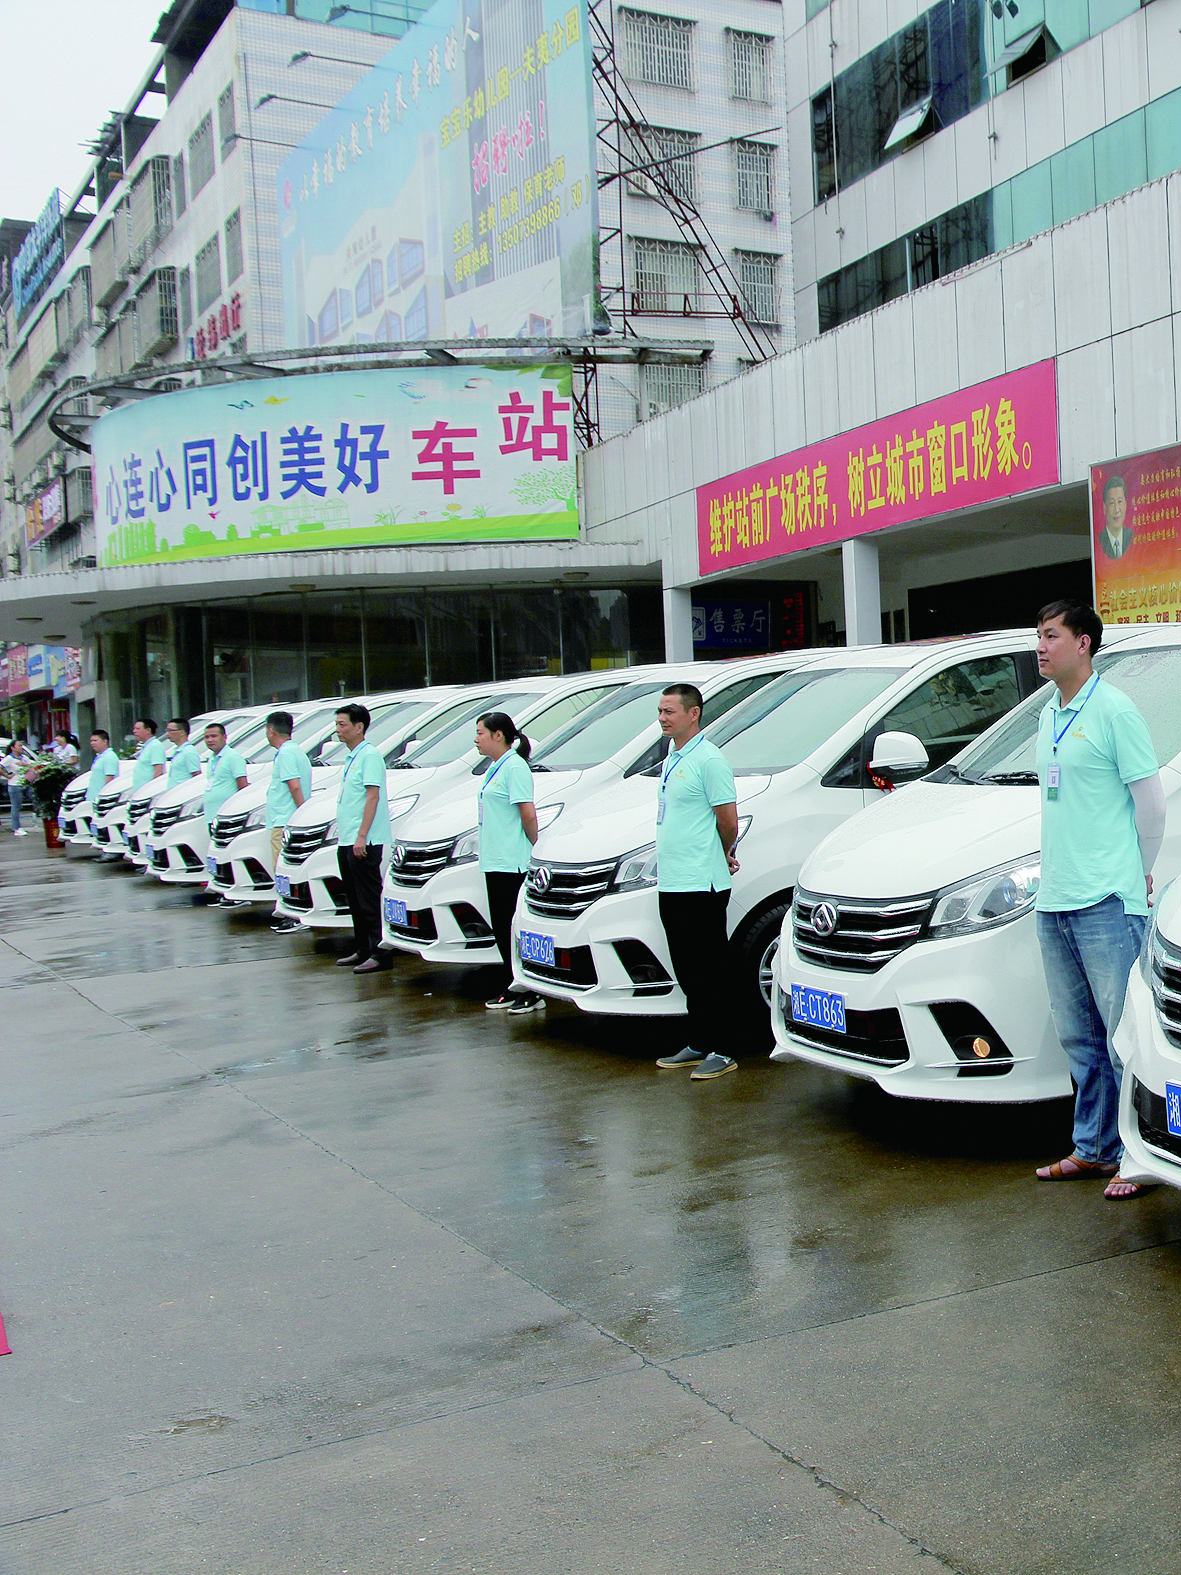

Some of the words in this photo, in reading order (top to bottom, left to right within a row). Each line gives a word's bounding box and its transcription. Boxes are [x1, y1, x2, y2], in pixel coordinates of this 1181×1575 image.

[709, 397, 1032, 557] 维护站前广场秩序，树立城市窗口形象。
[709, 607, 766, 633] 售票厅
